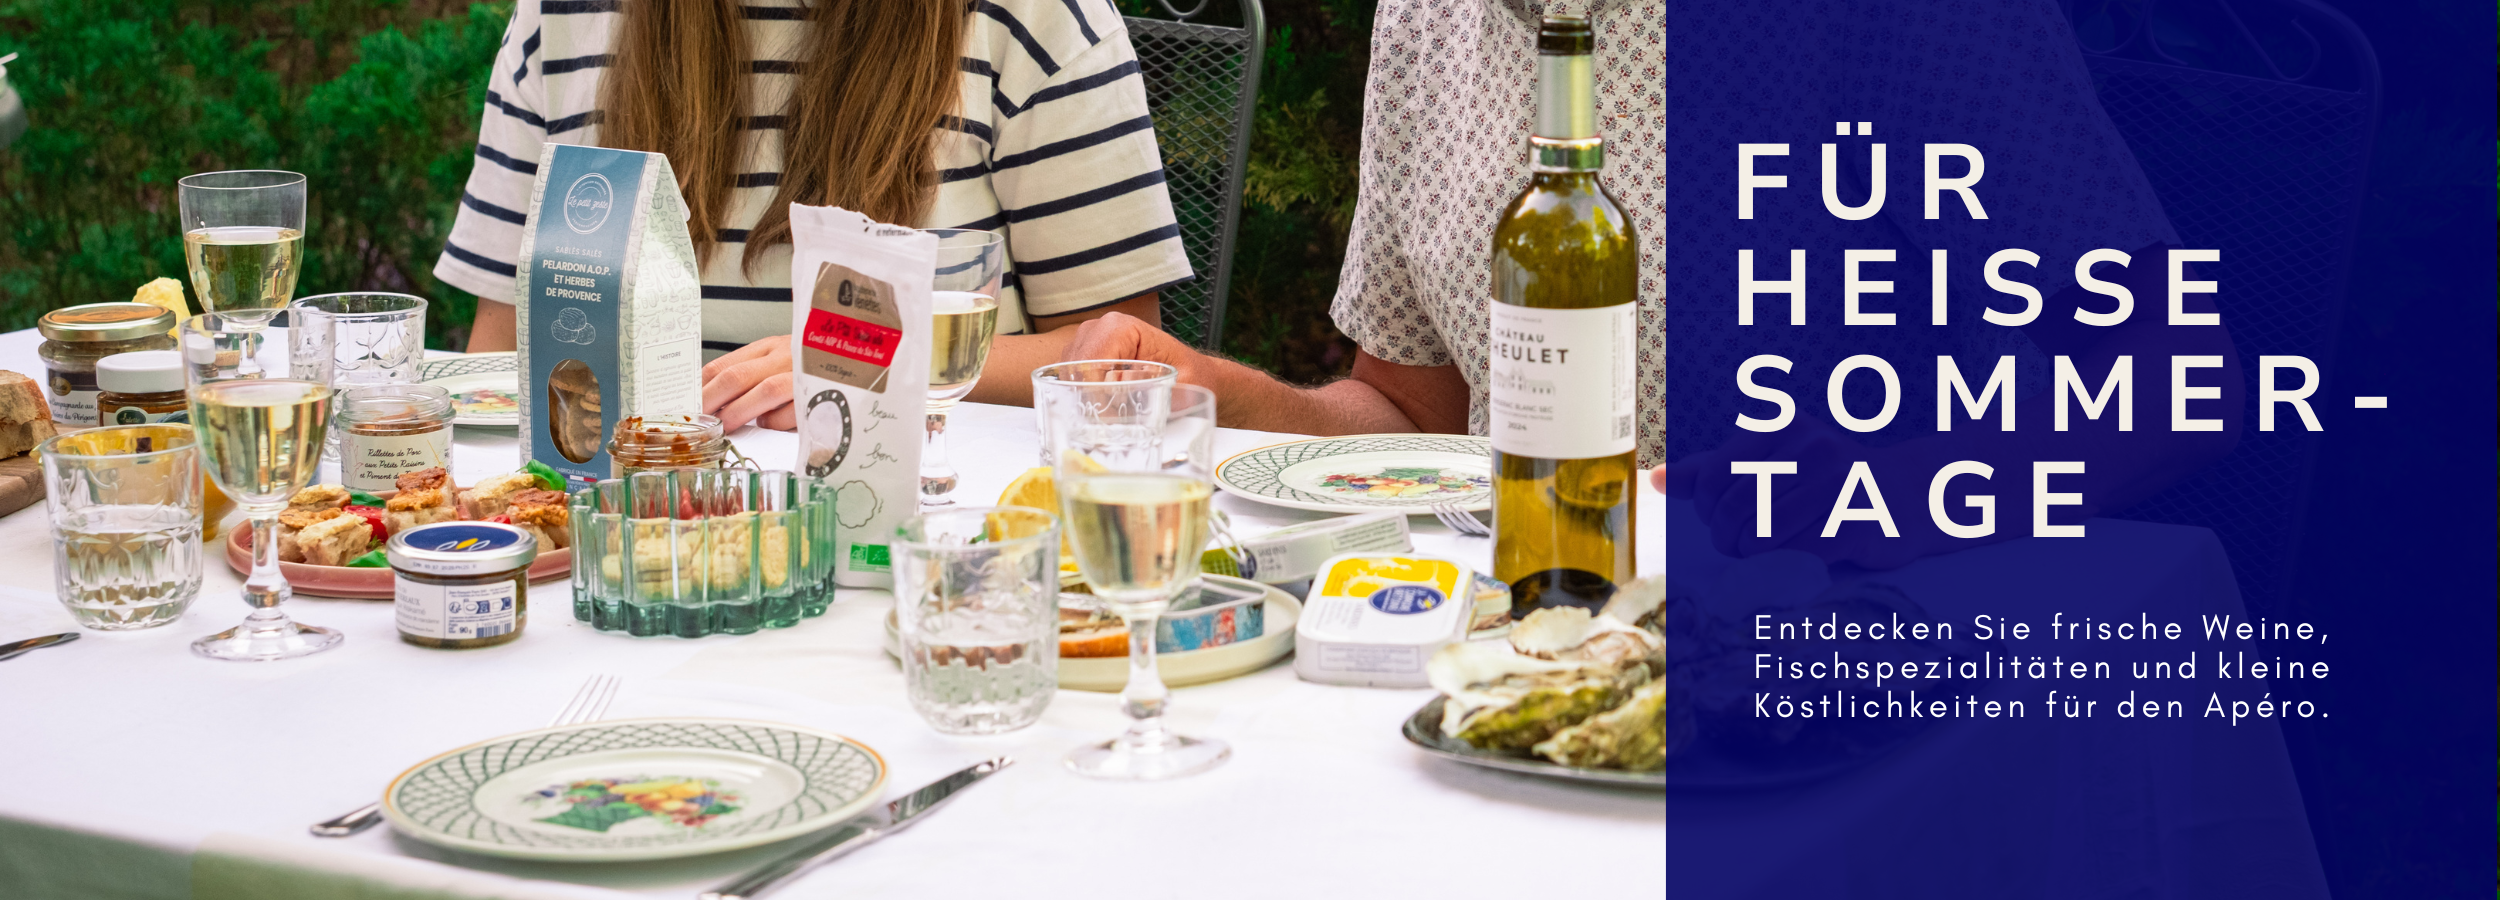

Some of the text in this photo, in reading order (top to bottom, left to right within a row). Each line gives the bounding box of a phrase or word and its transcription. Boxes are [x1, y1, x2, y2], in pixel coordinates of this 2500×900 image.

[556, 246, 602, 258] SABLÉS SALÉS
[543, 260, 587, 273] PELARDON
[554, 274, 595, 288] ET HERBES
[546, 287, 602, 303] DE PROVENCE
[1496, 327, 1545, 343] CHÂTEAU
[657, 351, 681, 361] L'HISTOIRE
[367, 447, 422, 457] Rillettes de Porc
[866, 442, 898, 463] bon
[379, 460, 398, 468] Petits
[400, 460, 425, 468] Raisins
[367, 470, 392, 480] Piment
[581, 469, 597, 478] FRANCE
